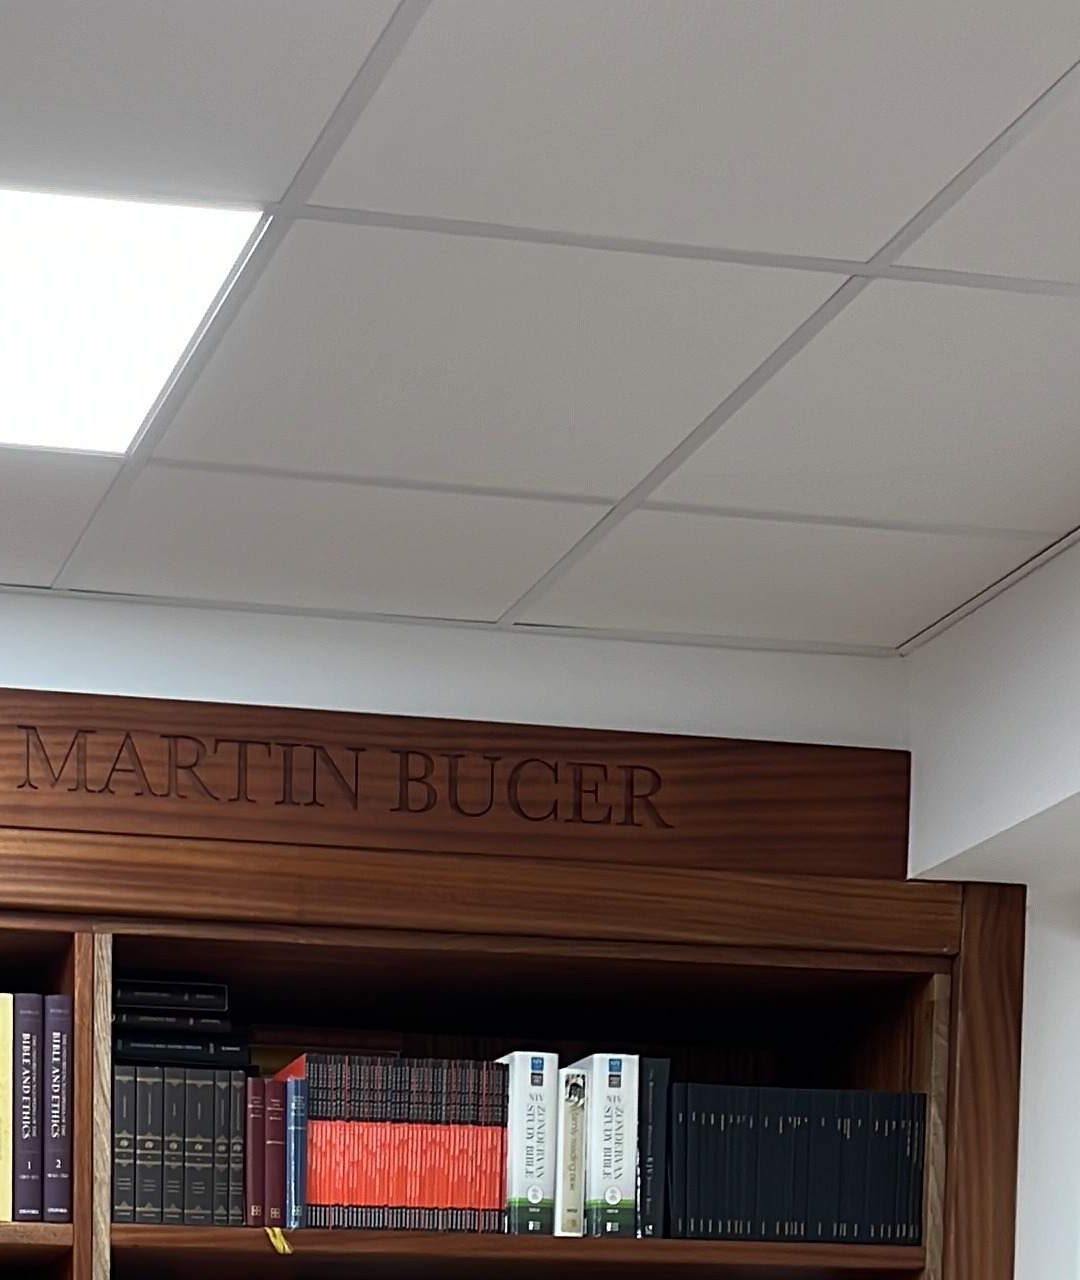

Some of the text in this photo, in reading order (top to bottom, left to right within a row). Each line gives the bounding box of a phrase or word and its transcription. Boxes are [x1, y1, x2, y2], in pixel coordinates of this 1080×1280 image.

[16, 725, 367, 810] MARTIN
[389, 749, 676, 829] BUCER
[51, 1032, 60, 1138] BIBLE AND ETHICS
[526, 1105, 536, 1178] STUDY BIBLE
[536, 1105, 545, 1179] ZONDERVAN
